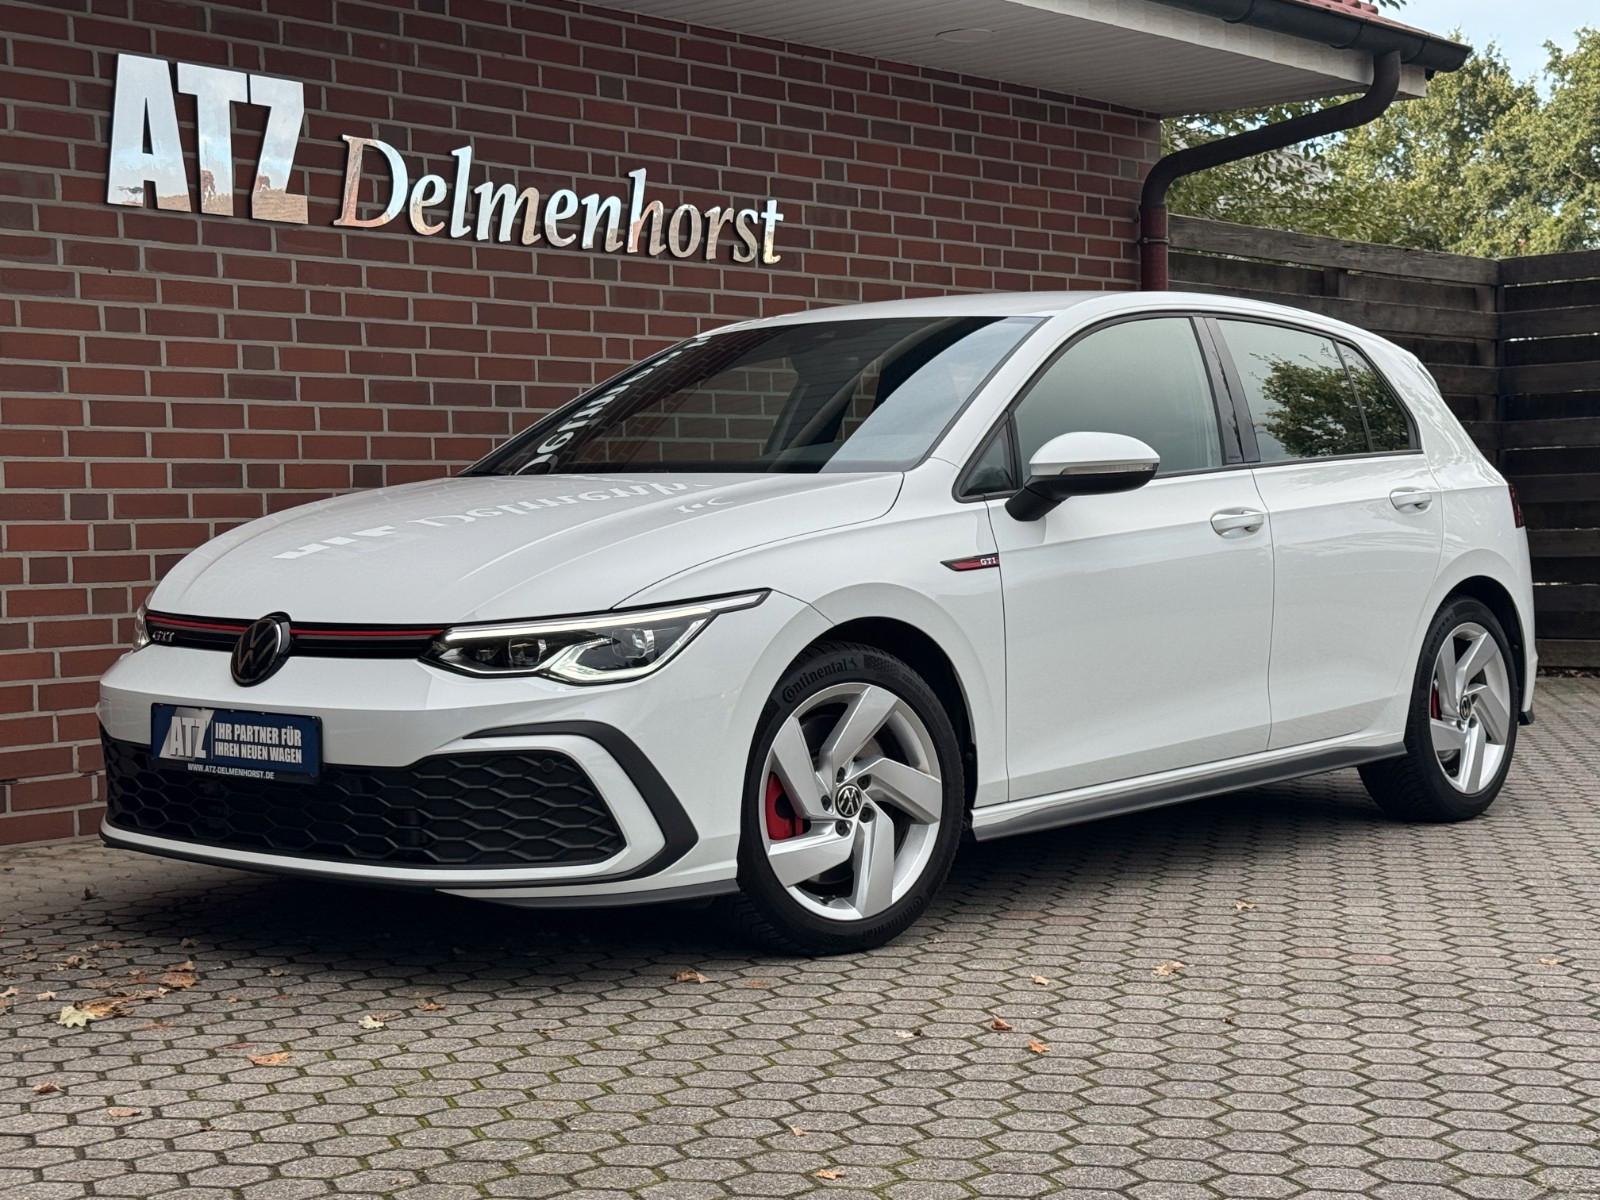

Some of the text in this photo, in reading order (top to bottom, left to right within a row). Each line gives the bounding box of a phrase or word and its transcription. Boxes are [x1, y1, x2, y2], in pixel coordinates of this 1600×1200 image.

[106, 53, 785, 265] ATZ Delmenhorst
[980, 556, 997, 566] GTI
[782, 656, 849, 703] Continental
[169, 716, 208, 759] ATZ
[215, 723, 302, 747] IHR PARTNER FÜR
[215, 741, 303, 763] IHREN NEUEN WAGEN
[187, 763, 275, 779] WWW.ATZ-DELMENHORST.DE
